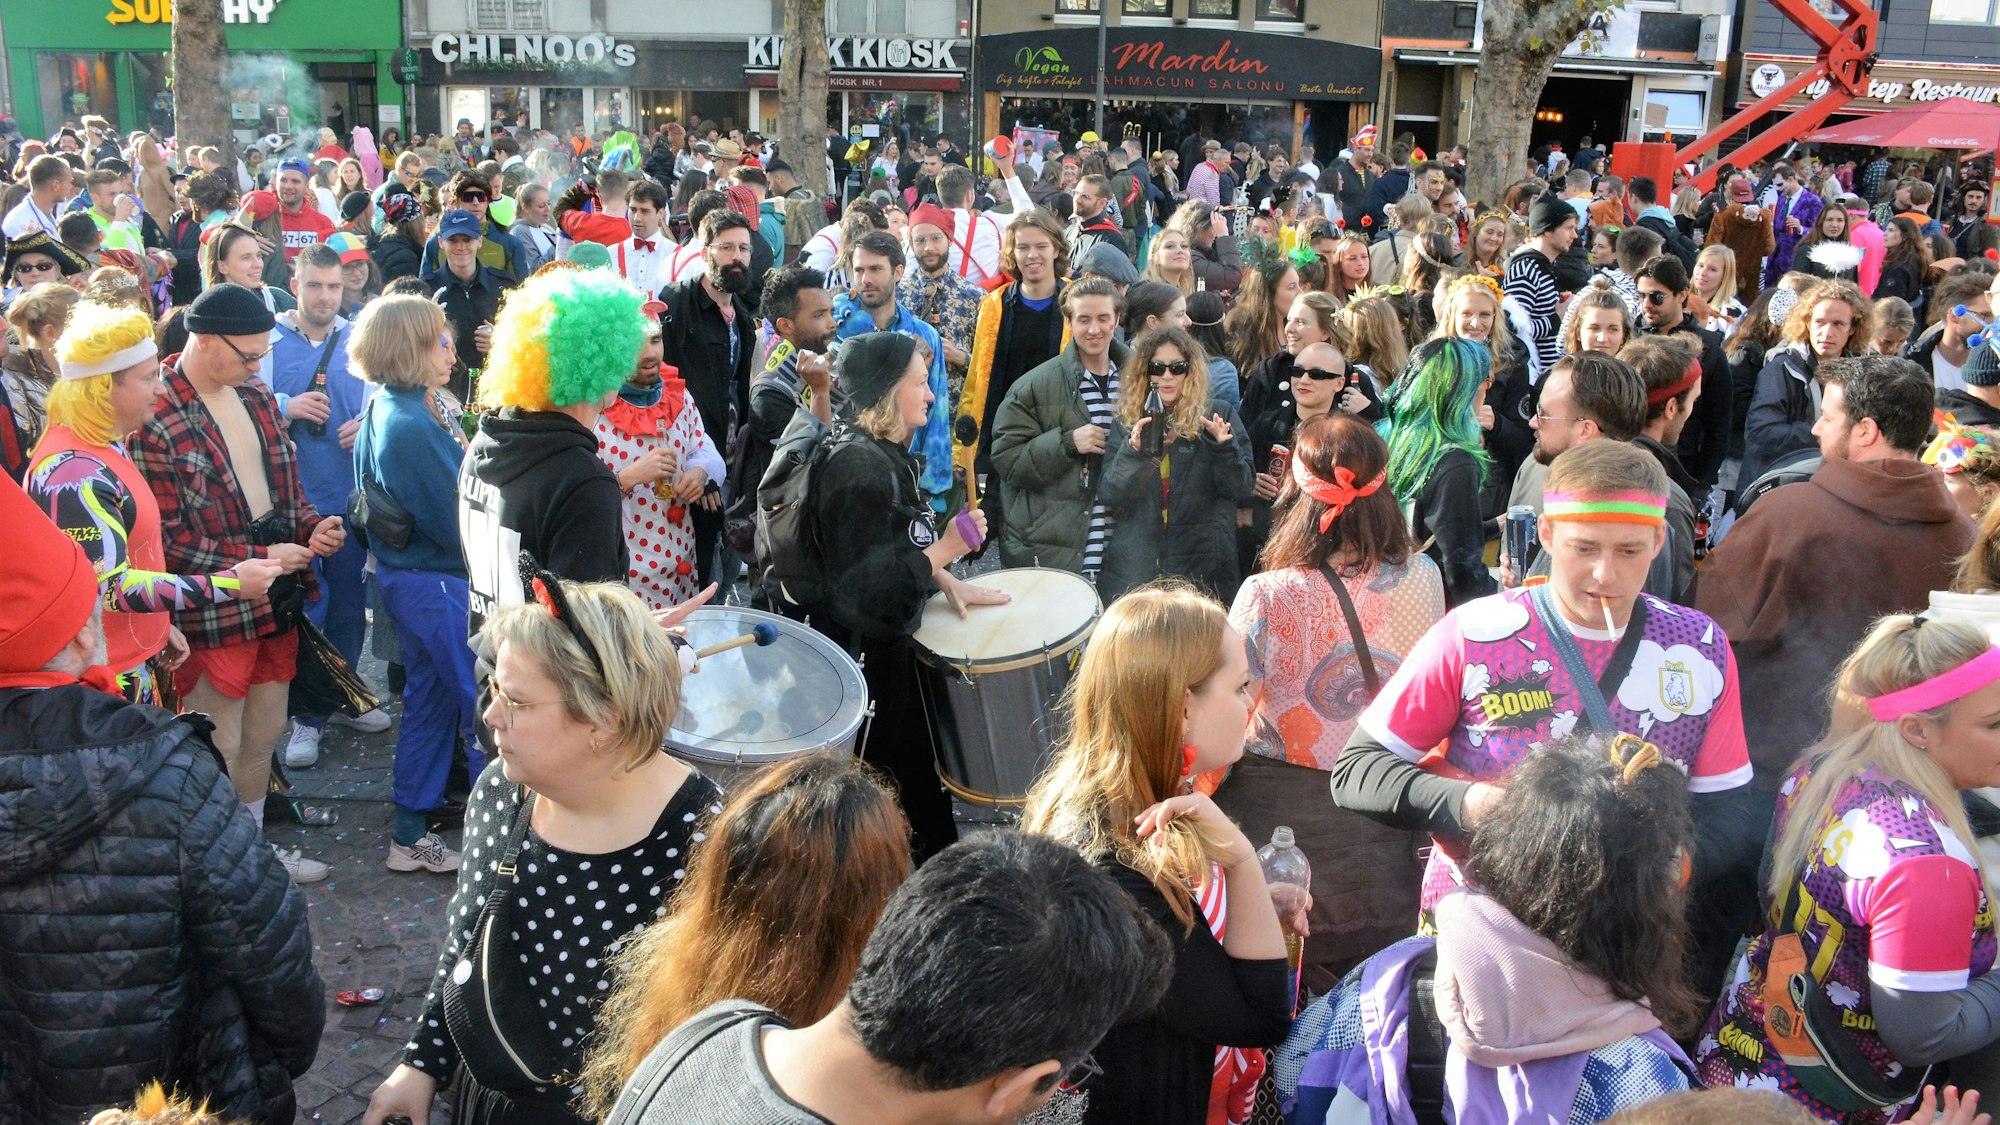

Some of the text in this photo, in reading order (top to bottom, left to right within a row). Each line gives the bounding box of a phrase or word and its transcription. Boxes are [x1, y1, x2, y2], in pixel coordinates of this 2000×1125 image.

[105, 0, 275, 25] SUAY
[748, 36, 956, 69] KIK KIOSK
[1015, 46, 1070, 75] Vegan
[1112, 39, 1269, 75] Mardin
[830, 78, 857, 86] KIOSK
[1090, 74, 1286, 92] LAHMACUN SALONU
[1909, 78, 2000, 104] Restaur
[1480, 690, 1554, 721] BOOM!
